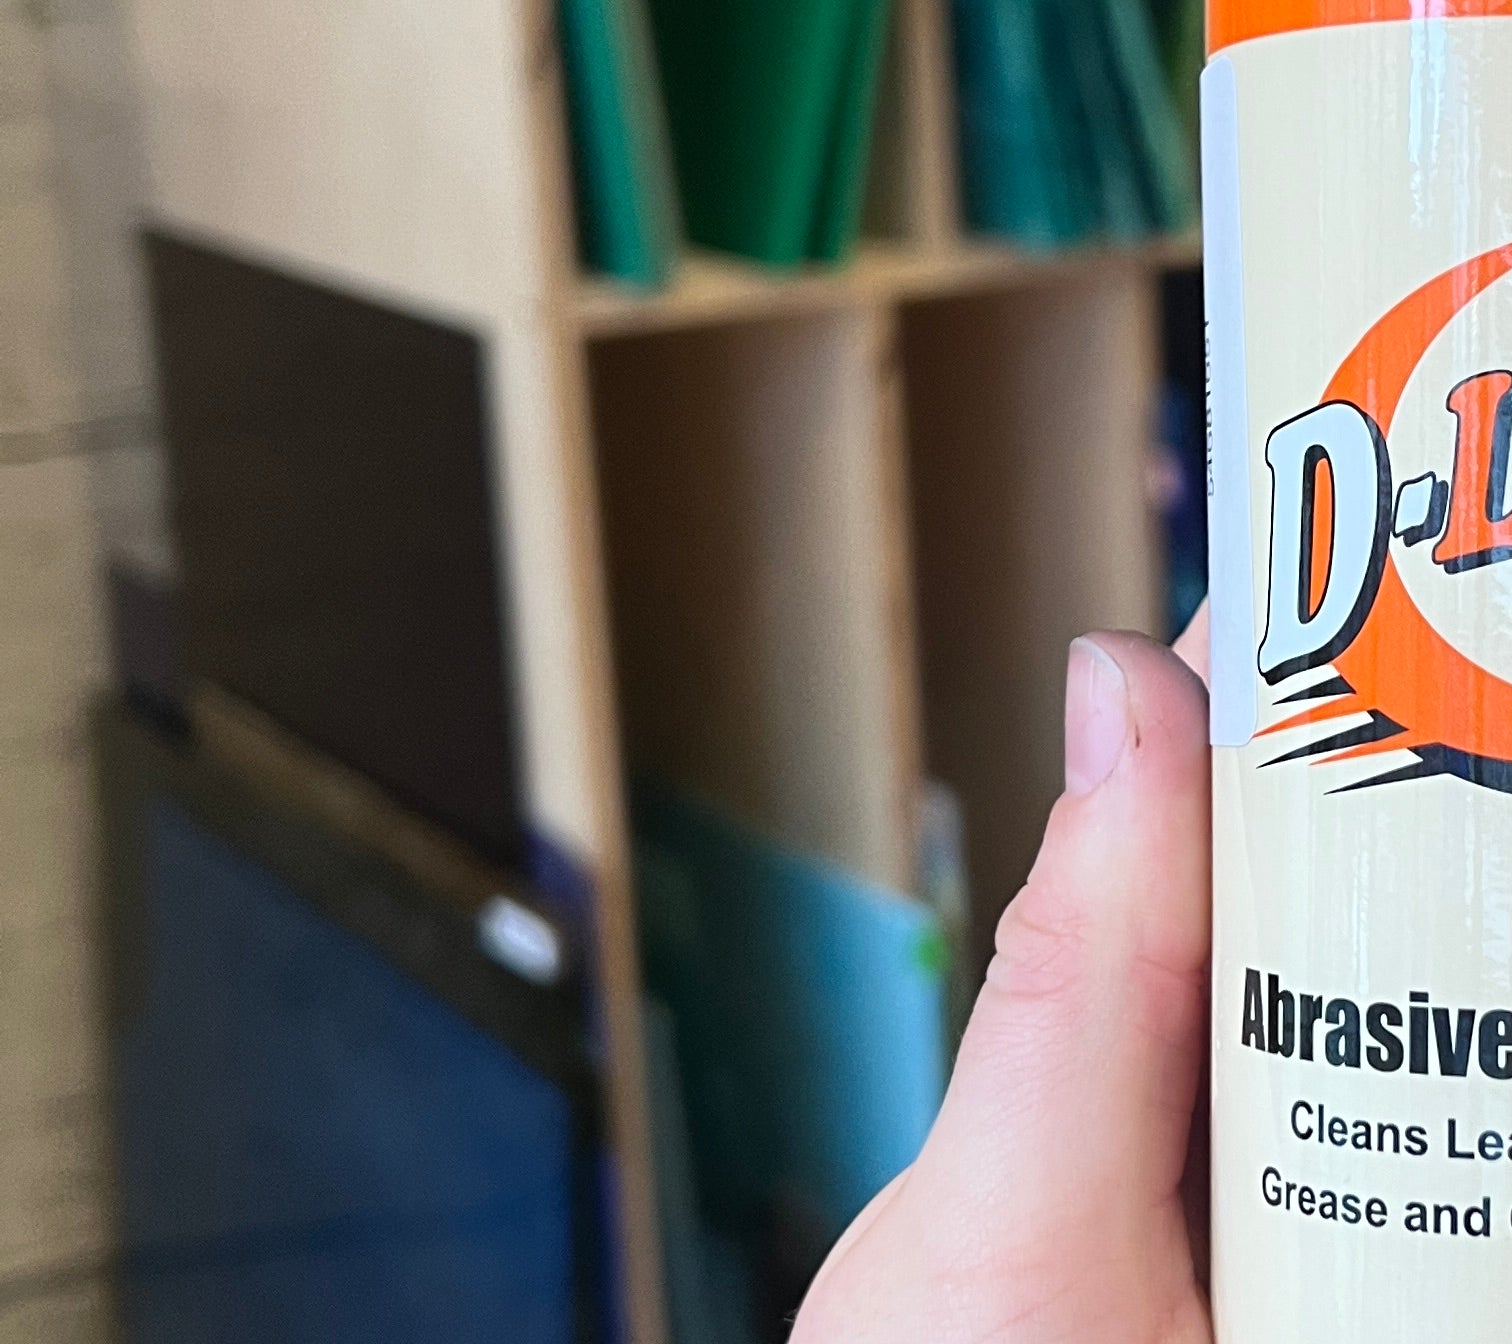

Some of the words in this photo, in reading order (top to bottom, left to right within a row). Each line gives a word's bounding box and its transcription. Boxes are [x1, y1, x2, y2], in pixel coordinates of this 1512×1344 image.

[1290, 1100, 1429, 1156] Cleans
[1261, 1166, 1388, 1227] Grease
[1404, 1196, 1491, 1237] and
